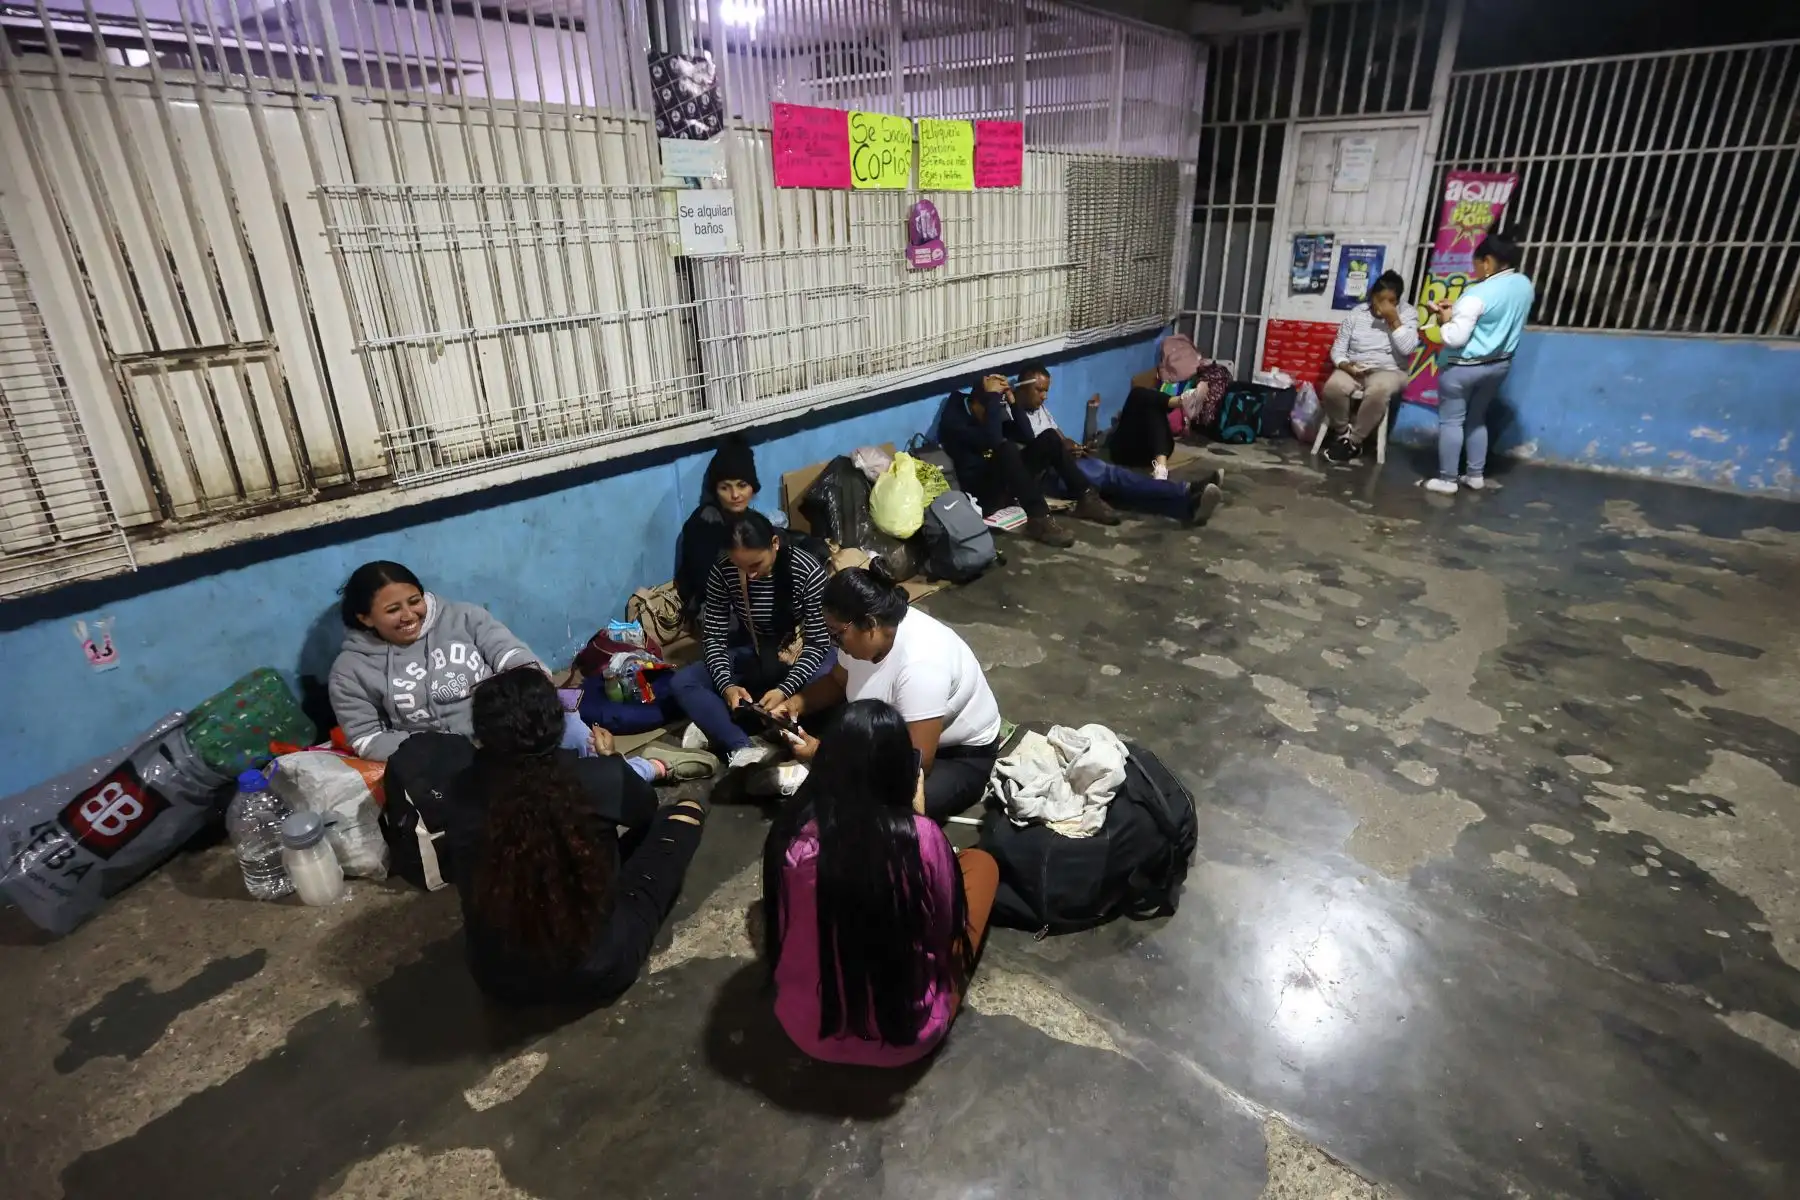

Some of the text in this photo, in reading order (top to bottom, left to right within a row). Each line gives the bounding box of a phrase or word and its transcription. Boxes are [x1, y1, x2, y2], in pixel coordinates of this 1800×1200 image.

[852, 113, 876, 144] Se
[680, 204, 733, 220] Se alquilan
[694, 222, 724, 235] baños
